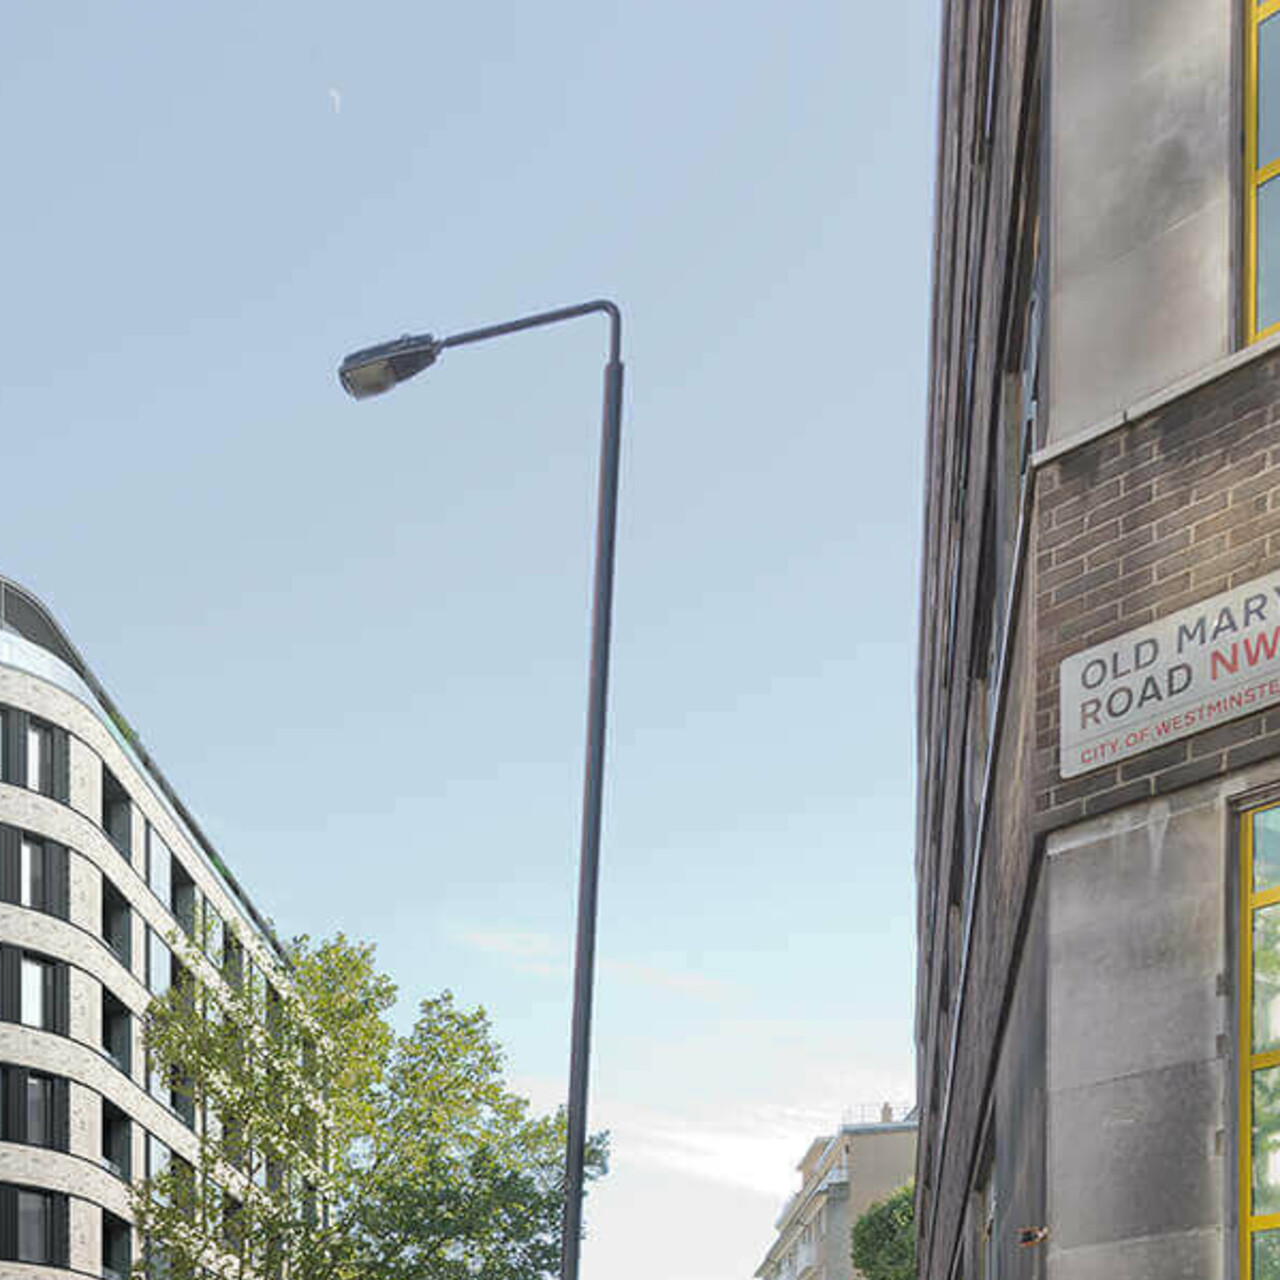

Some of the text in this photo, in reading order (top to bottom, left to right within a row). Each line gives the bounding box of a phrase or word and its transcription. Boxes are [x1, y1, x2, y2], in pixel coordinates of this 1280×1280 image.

[1080, 626, 1280, 729] ROAD NW
[1081, 586, 1280, 690] OLD MAR
[1081, 739, 1119, 764] CITY
[1125, 727, 1150, 747] OF
